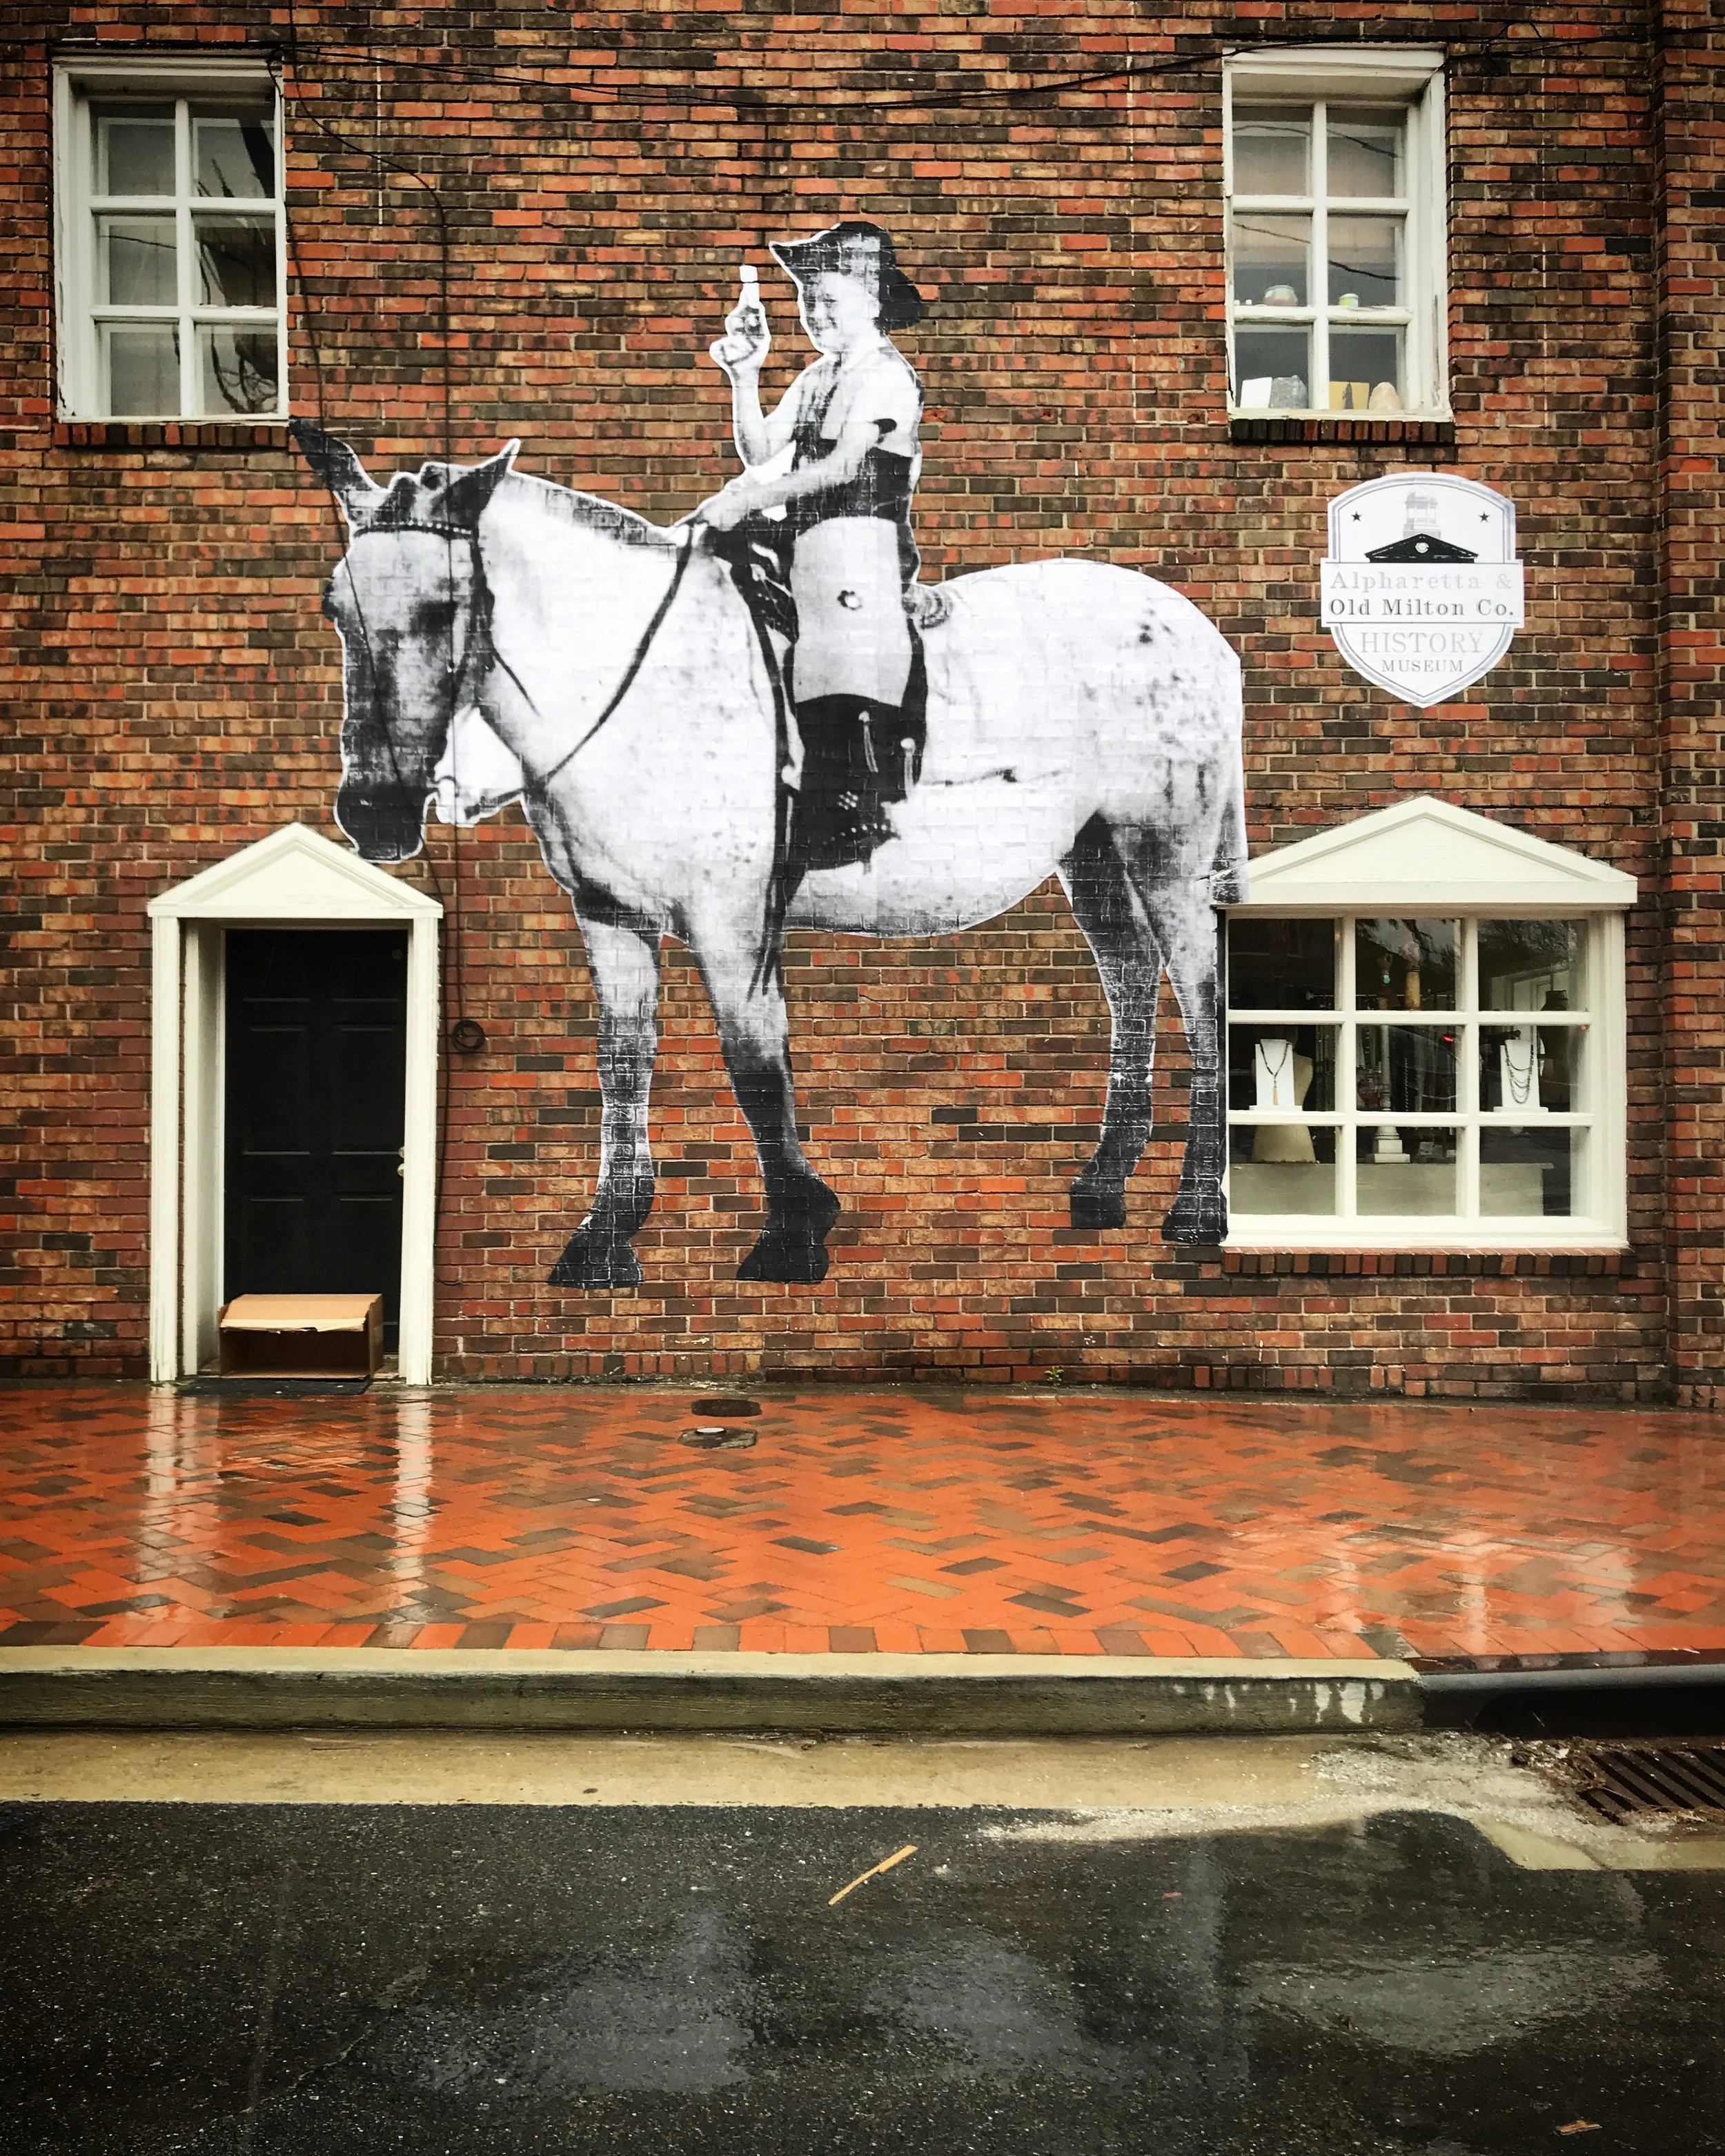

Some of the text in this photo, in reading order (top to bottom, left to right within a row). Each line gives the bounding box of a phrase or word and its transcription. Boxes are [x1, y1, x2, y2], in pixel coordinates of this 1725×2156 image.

[1330, 571, 1512, 593] Alpharetta &
[1329, 598, 1514, 617] Old Milton Co.
[1360, 632, 1483, 653] HISTORY
[1381, 660, 1463, 673] MUSEUM
